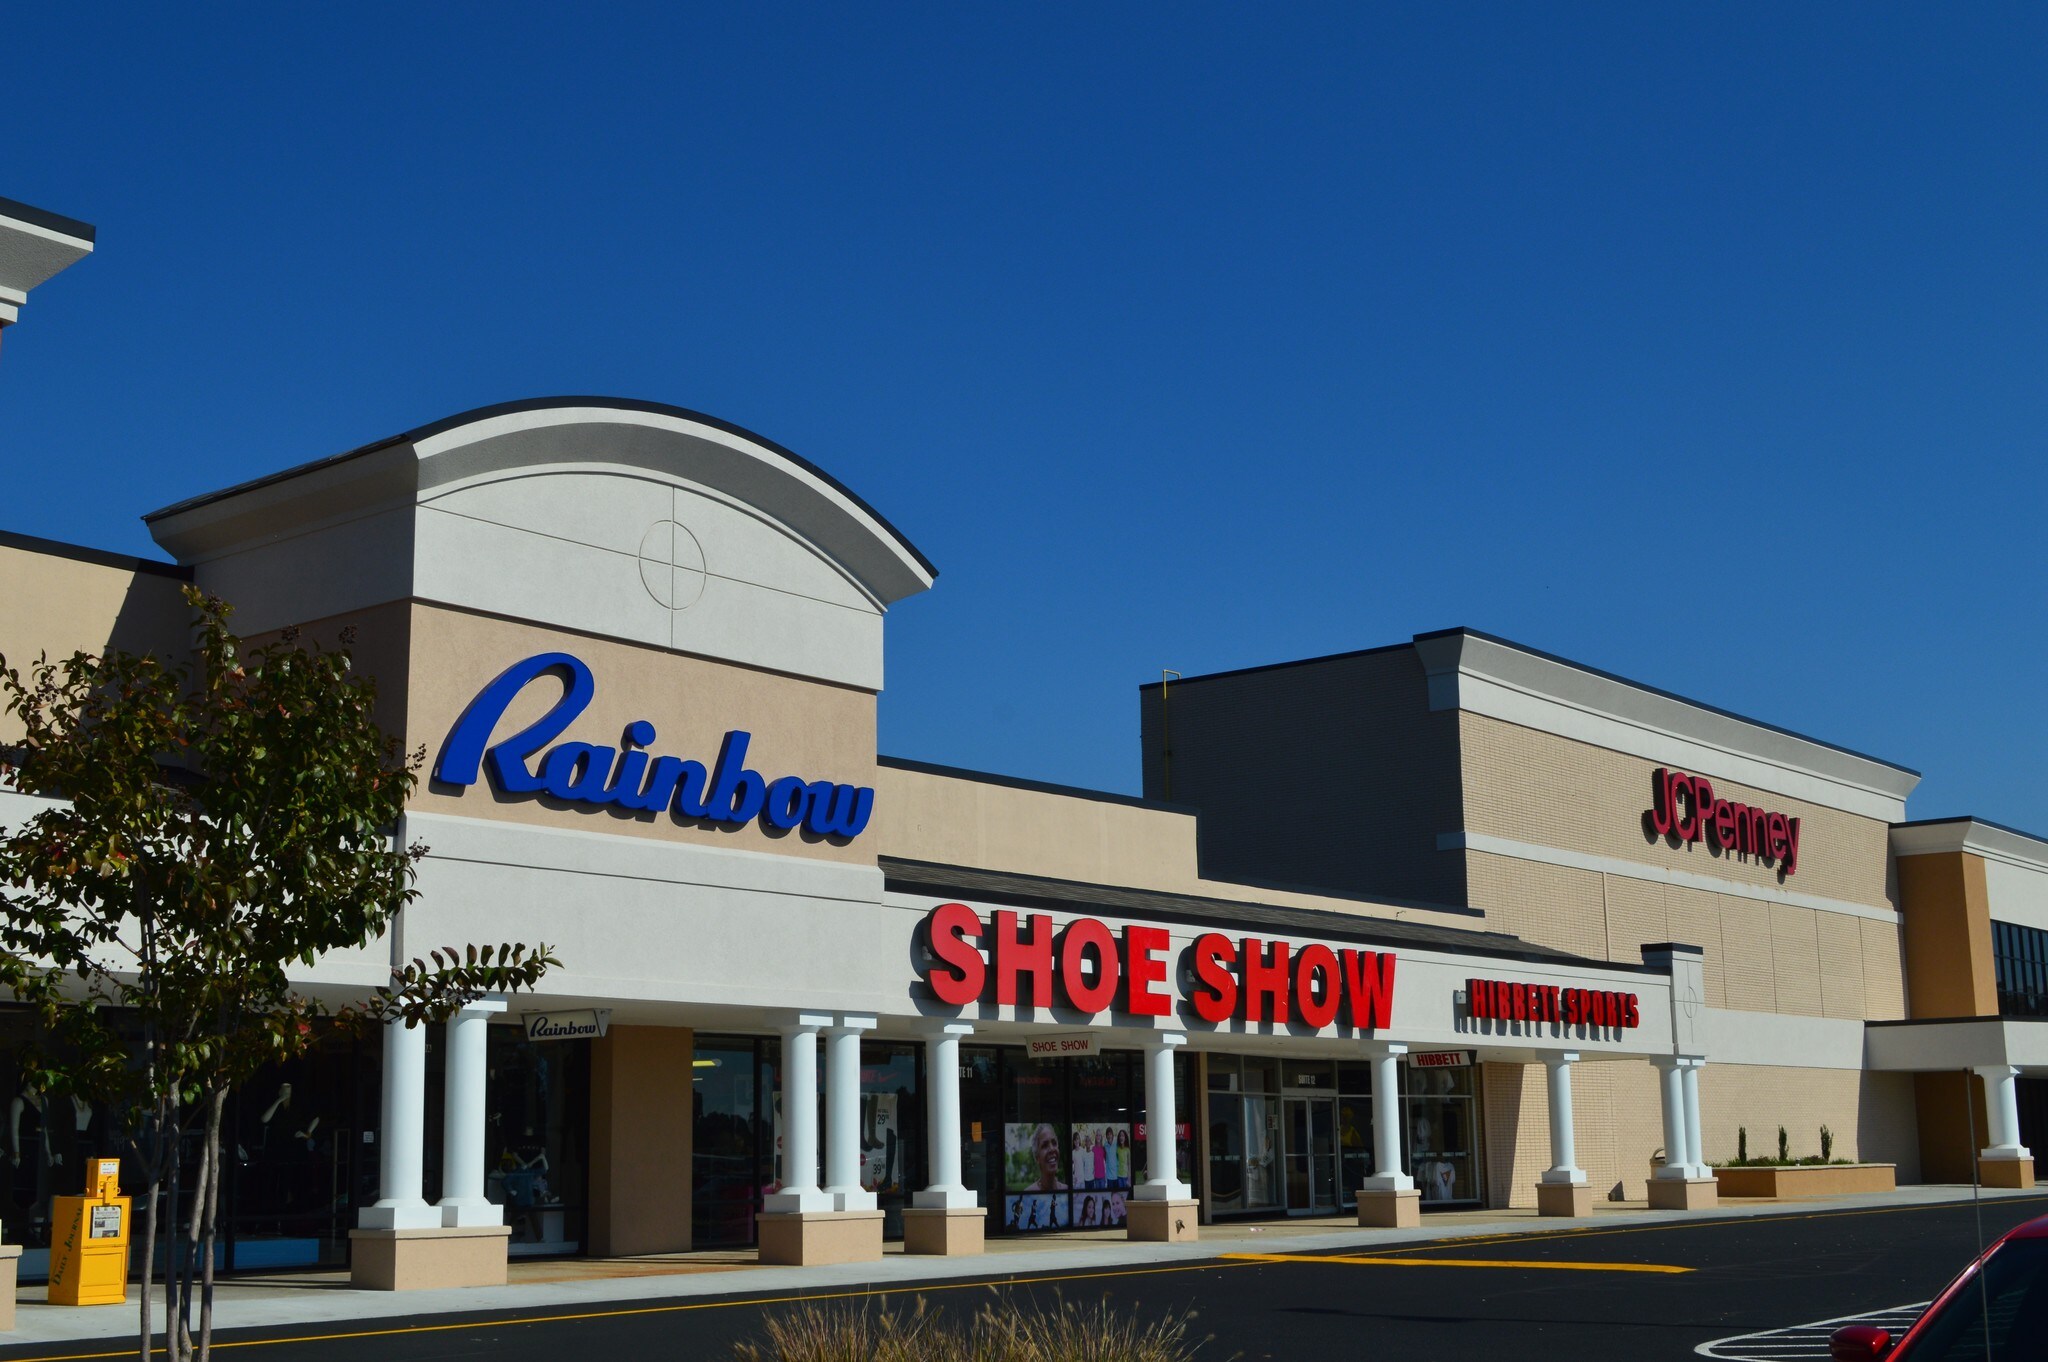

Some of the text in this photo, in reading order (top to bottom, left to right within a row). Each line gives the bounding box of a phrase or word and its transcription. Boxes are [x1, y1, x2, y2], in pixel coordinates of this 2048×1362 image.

[433, 652, 874, 838] Rainbow
[1652, 768, 1800, 875] JCPenney
[926, 902, 1396, 1030] SHOE SHOW
[1468, 978, 1640, 1029] HIBBETT SPORTS
[529, 1016, 596, 1037] Rainbow
[1032, 1039, 1088, 1052] SHOE SHOW
[1416, 1052, 1461, 1067] HIBBETT
[967, 1066, 973, 1078] 11
